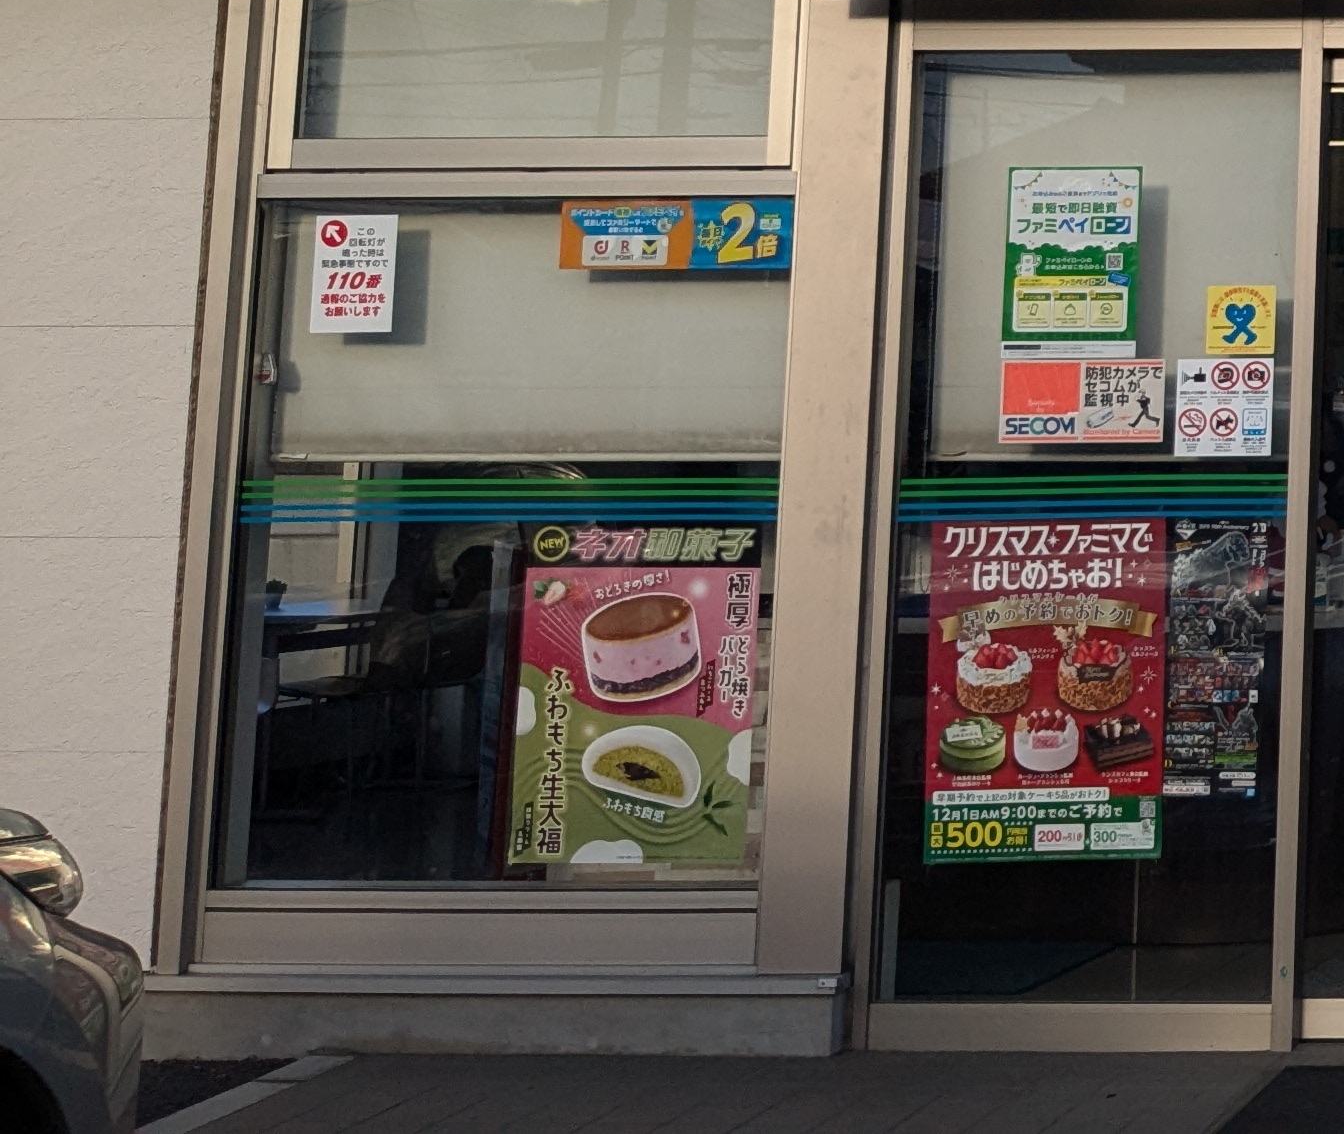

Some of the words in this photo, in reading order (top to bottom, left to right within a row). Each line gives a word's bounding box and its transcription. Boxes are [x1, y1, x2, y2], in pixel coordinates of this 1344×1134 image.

[1032, 202, 1118, 214] 最短で即日融資
[357, 227, 376, 236] この
[326, 271, 382, 290] 110番
[324, 306, 382, 317] お願いします
[1085, 366, 1164, 380] 防犯カメラで
[1085, 379, 1141, 393] セコムが
[1084, 393, 1130, 407] 監視中
[1005, 417, 1076, 435] SECOM
[540, 537, 565, 550] NEW
[571, 527, 756, 562] ネオ和菓子
[972, 558, 1124, 591] はじめちゃお!
[727, 572, 751, 628] 極厚
[718, 635, 735, 704] バーガー
[731, 635, 750, 719] どら焼き
[536, 669, 572, 855] ふわもち生大福
[946, 821, 1003, 847] 500
